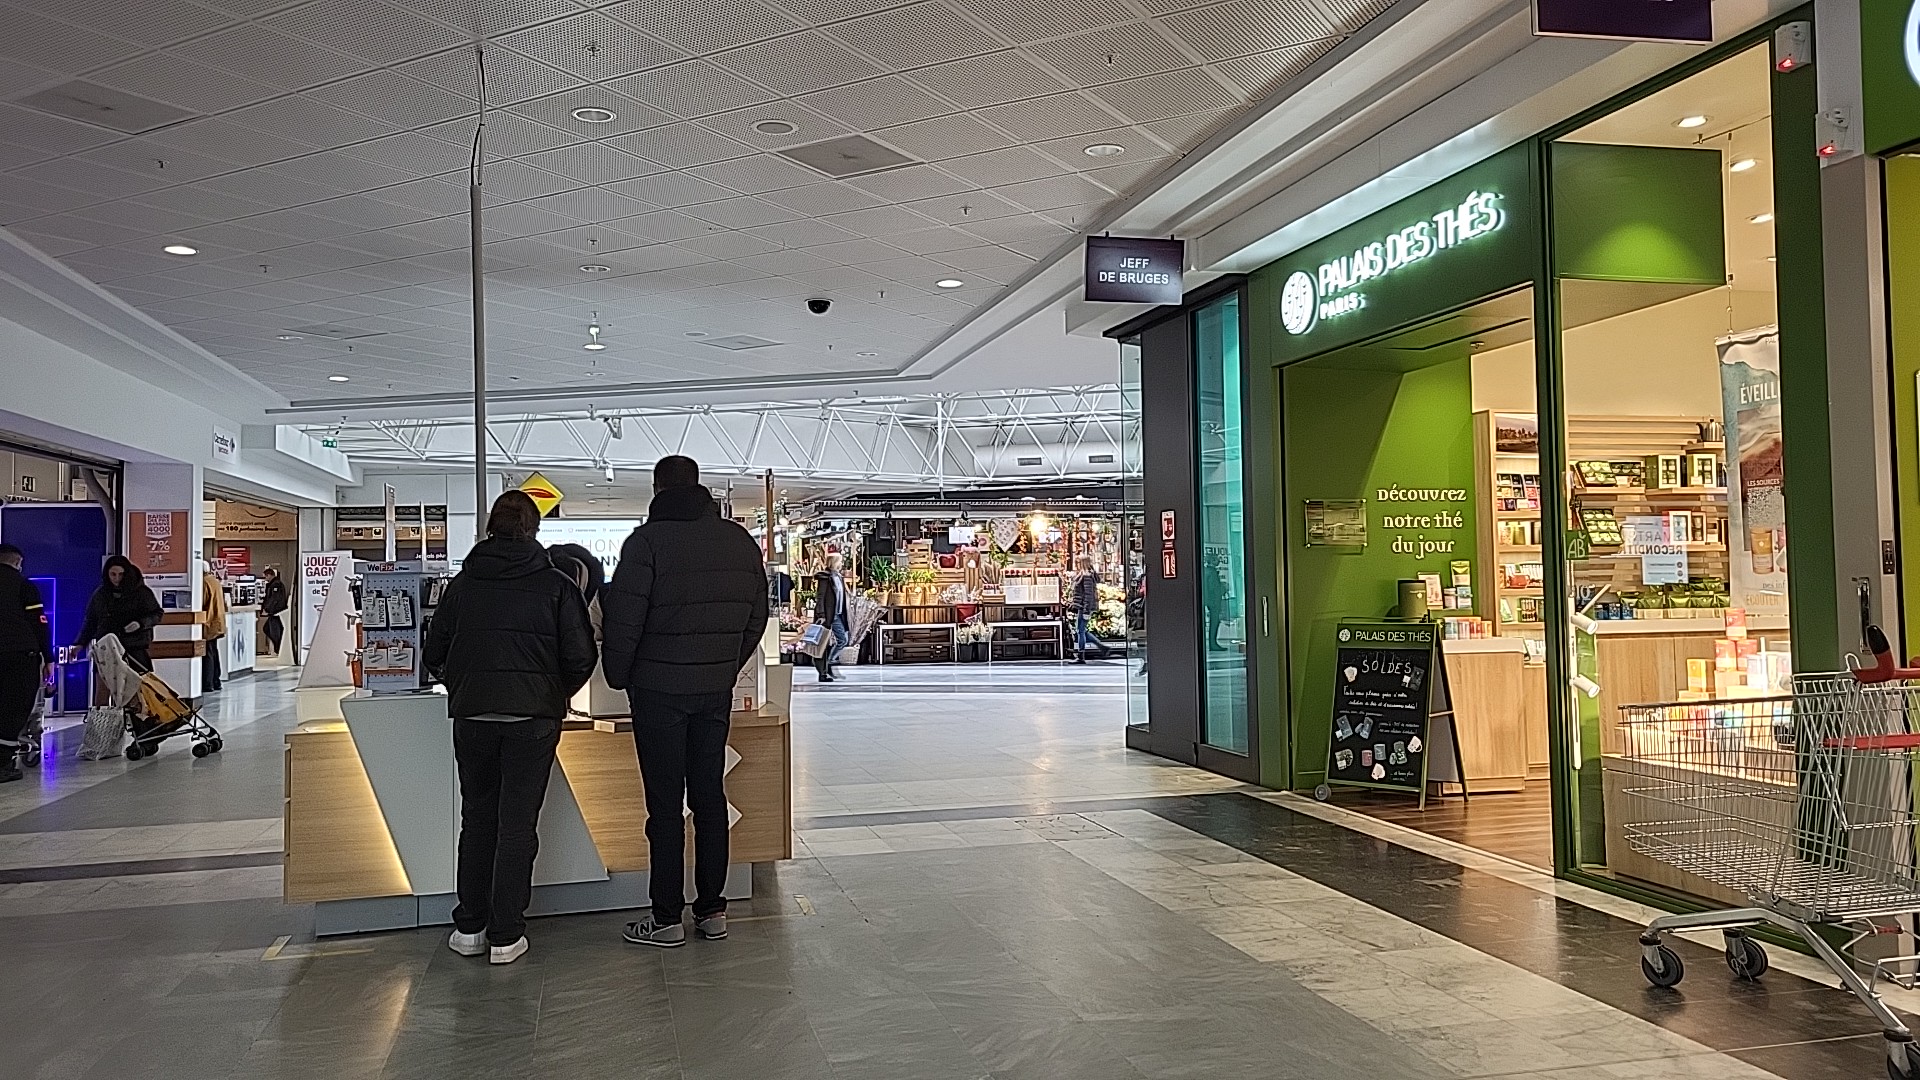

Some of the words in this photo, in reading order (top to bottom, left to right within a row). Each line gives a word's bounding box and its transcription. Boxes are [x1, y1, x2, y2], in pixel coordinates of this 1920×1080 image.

[1318, 242, 1384, 297] PALAIS
[1386, 221, 1432, 270] DES
[1433, 190, 1499, 249] THÉS
[1119, 257, 1150, 269] JEFF
[1099, 271, 1116, 283] DE
[1119, 272, 1169, 285] BRUGES
[1319, 292, 1360, 320] PARIS
[1740, 381, 1778, 405] ÉVEILL
[1376, 483, 1467, 501] Découvrez
[1383, 513, 1431, 528] notre
[1433, 510, 1463, 528] thé
[146, 540, 170, 551] -7%
[1392, 535, 1414, 553] du
[1415, 534, 1455, 559] jour
[303, 556, 338, 567] JOUEZ
[367, 563, 394, 572] WeFix
[1355, 630, 1385, 641] PALAIS
[1388, 631, 1405, 641] DES
[1407, 630, 1431, 642] THÉS
[1361, 660, 1412, 674] SOLDES
[639, 921, 651, 935] N
